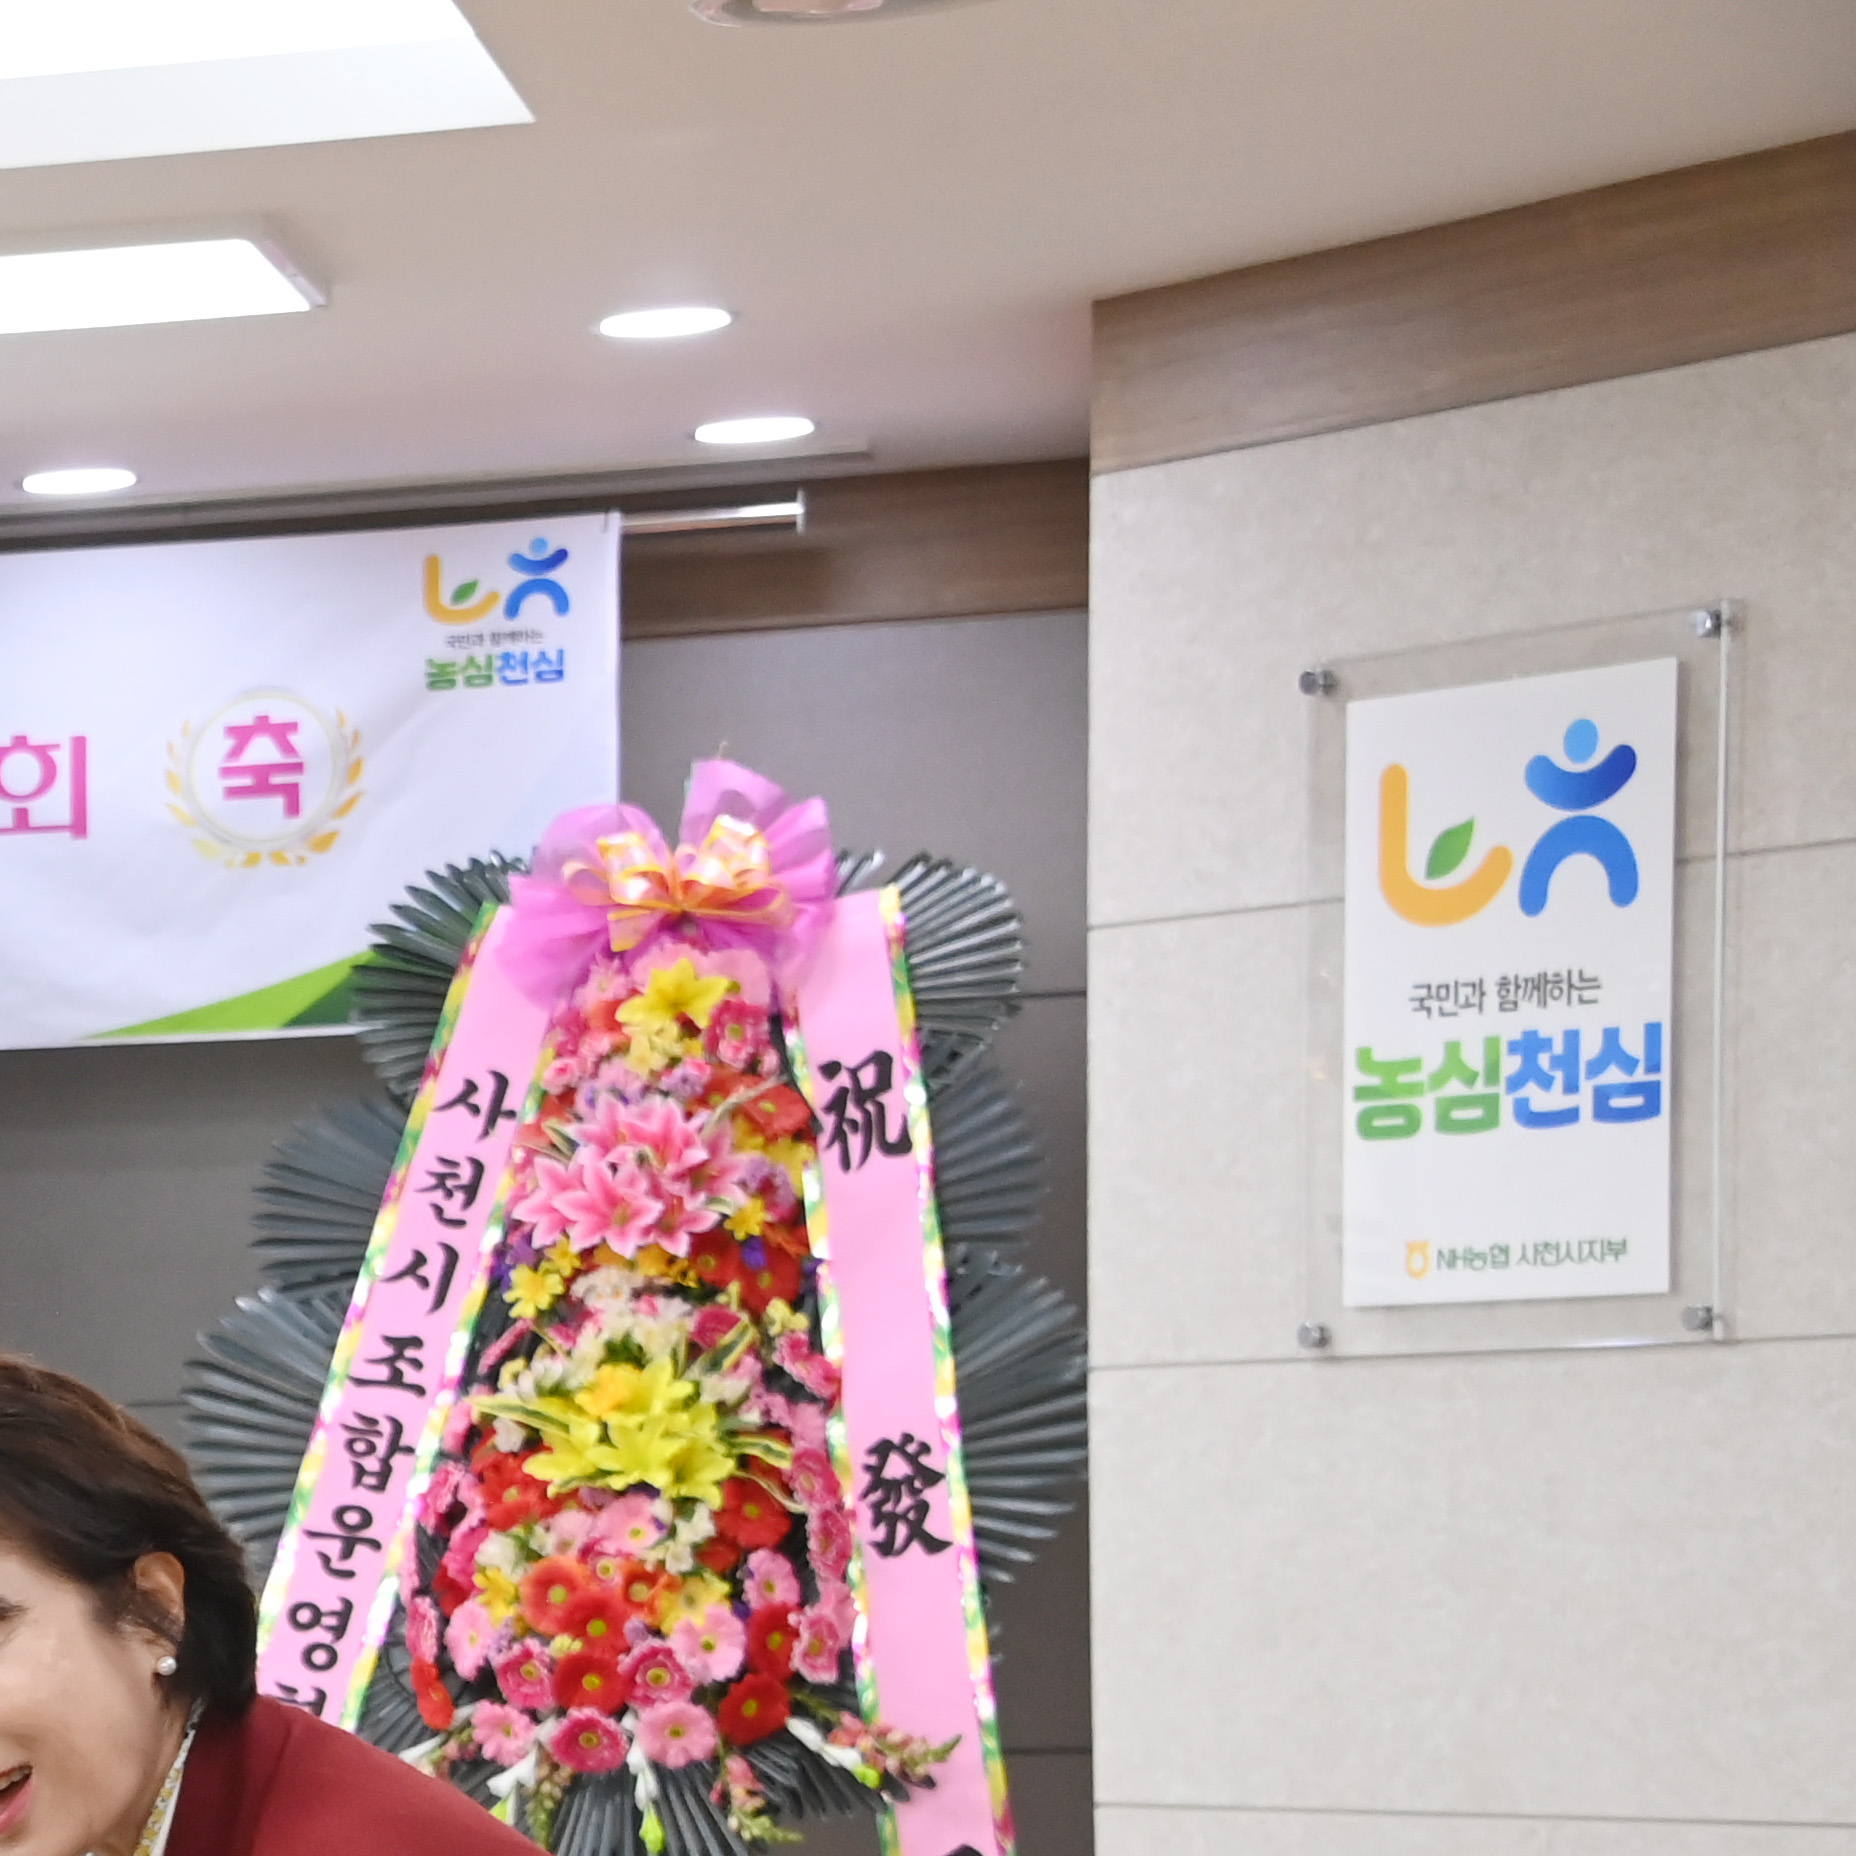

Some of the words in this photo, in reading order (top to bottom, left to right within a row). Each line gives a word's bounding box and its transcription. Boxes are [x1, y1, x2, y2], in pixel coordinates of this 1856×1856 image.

[445, 632, 485, 650] 국민과
[424, 648, 565, 691] 농심천심
[218, 715, 305, 820] 축
[1408, 977, 1486, 1019] 국민과
[1496, 969, 1601, 1012] 함께하는
[1352, 1021, 1664, 1141] 농심천심
[1516, 1238, 1628, 1267] 사천시지부
